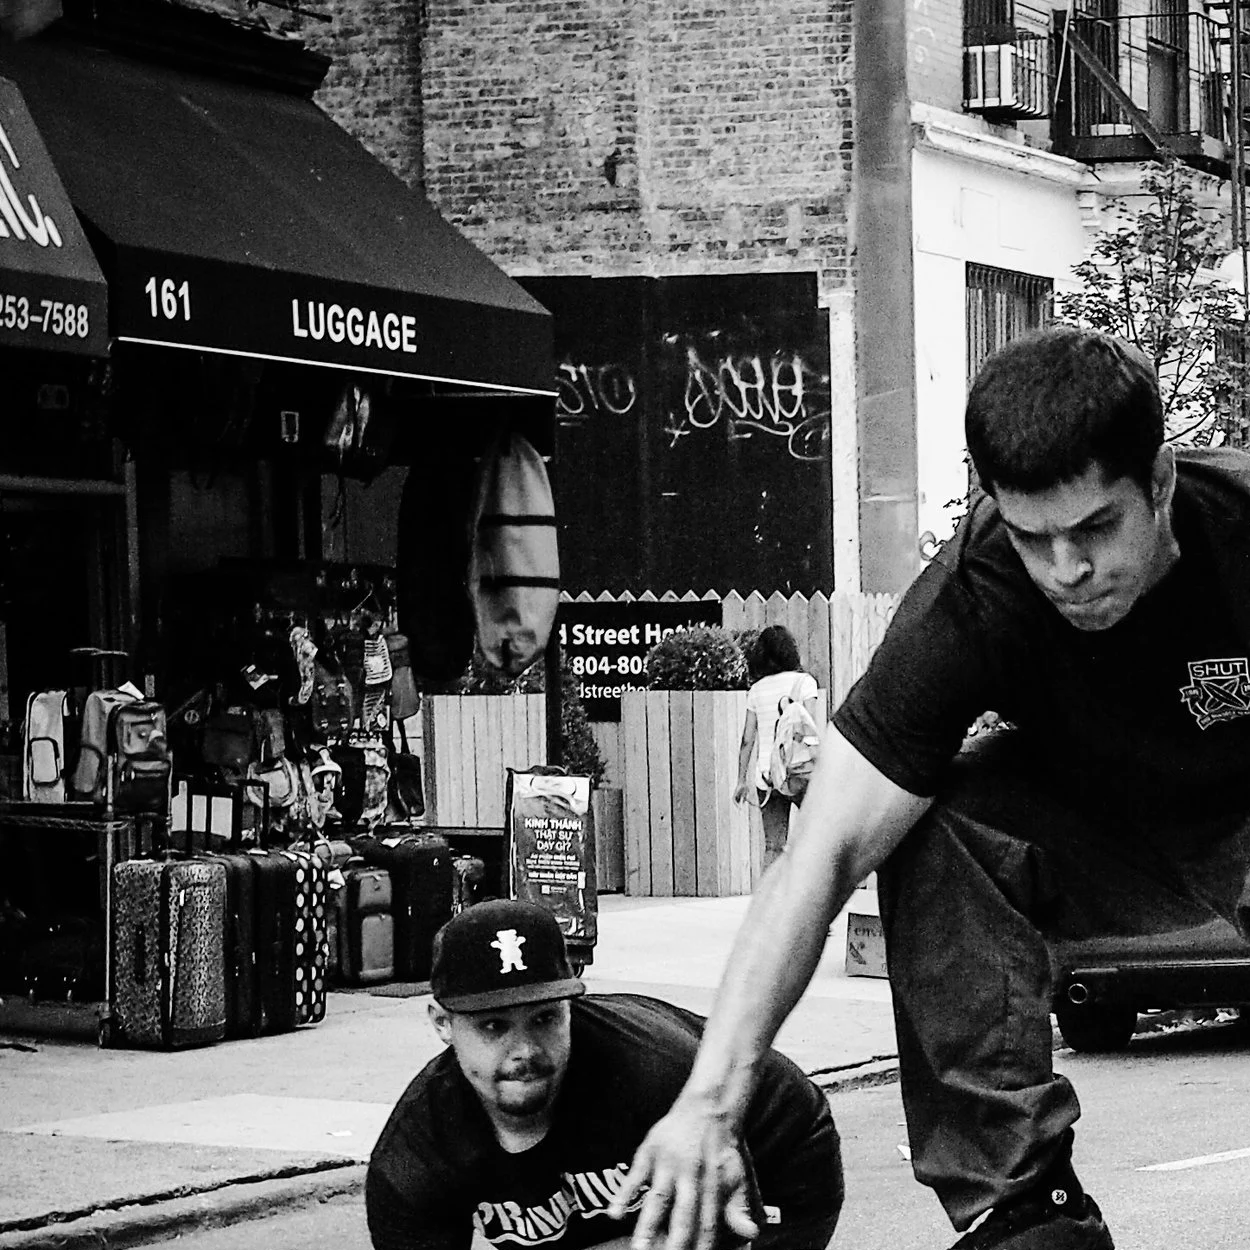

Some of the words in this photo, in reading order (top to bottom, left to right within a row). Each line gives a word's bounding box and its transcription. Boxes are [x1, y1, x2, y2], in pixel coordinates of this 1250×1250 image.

[145, 276, 191, 321] 161
[292, 299, 418, 353] LUGGAGE
[572, 624, 640, 645] Street
[1193, 662, 1243, 677] SHUT
[525, 818, 549, 829] KINH
